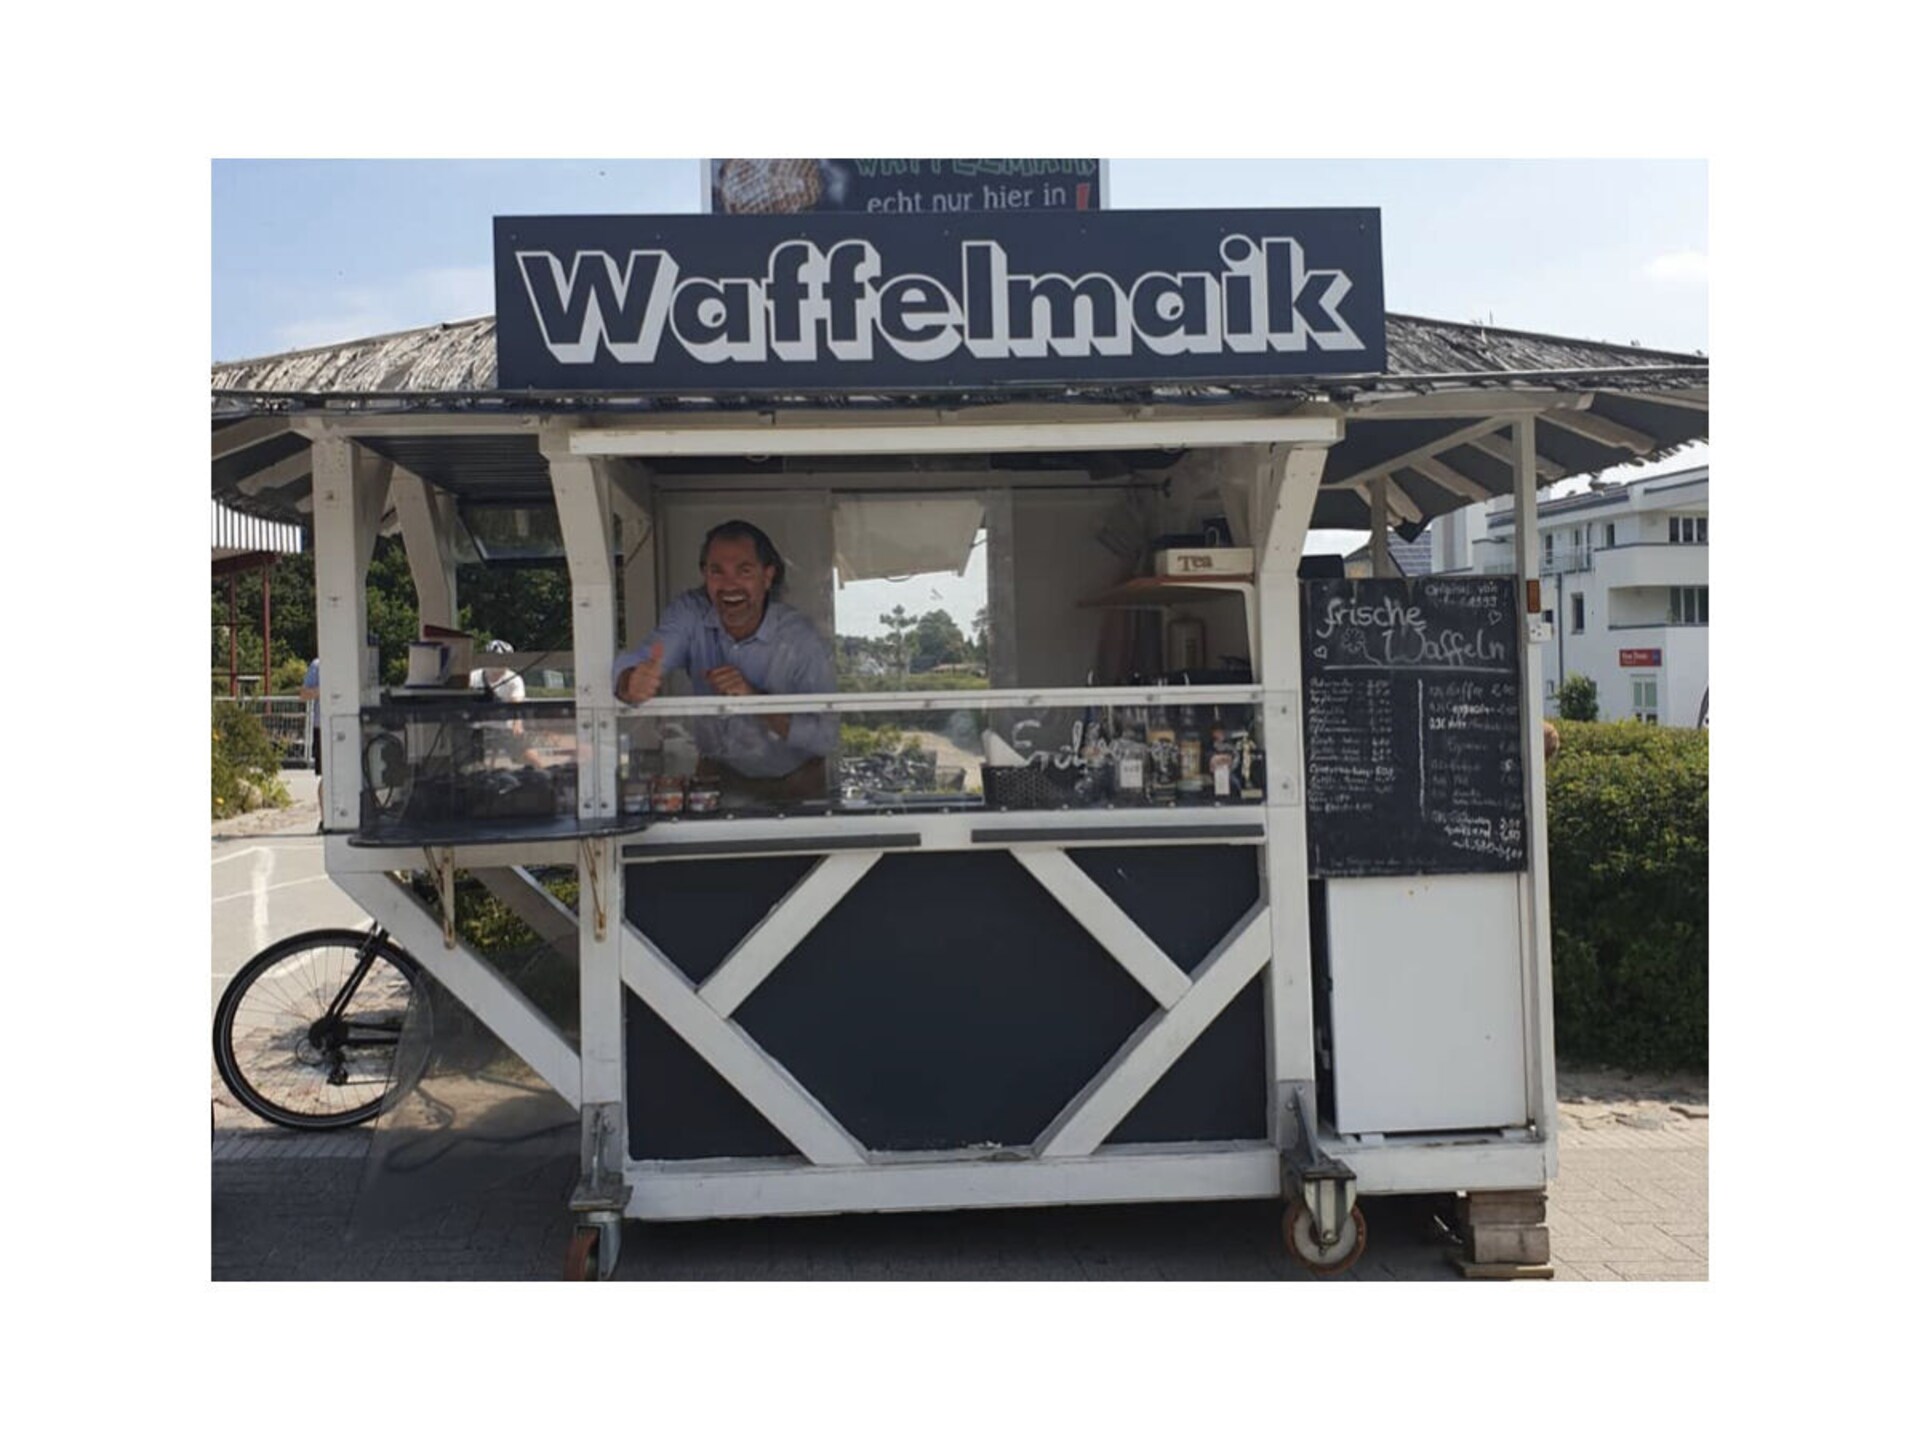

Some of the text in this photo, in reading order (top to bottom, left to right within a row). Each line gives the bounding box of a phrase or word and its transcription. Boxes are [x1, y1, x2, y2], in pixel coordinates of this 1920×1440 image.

[867, 190, 922, 213] echt
[932, 193, 974, 212] nur
[983, 184, 1034, 209] hier
[1043, 182, 1067, 205] in
[515, 233, 1366, 364] Waffelmaik
[1177, 555, 1213, 572] Tea
[1316, 595, 1427, 638] frische
[1382, 625, 1505, 667] Waffeln
